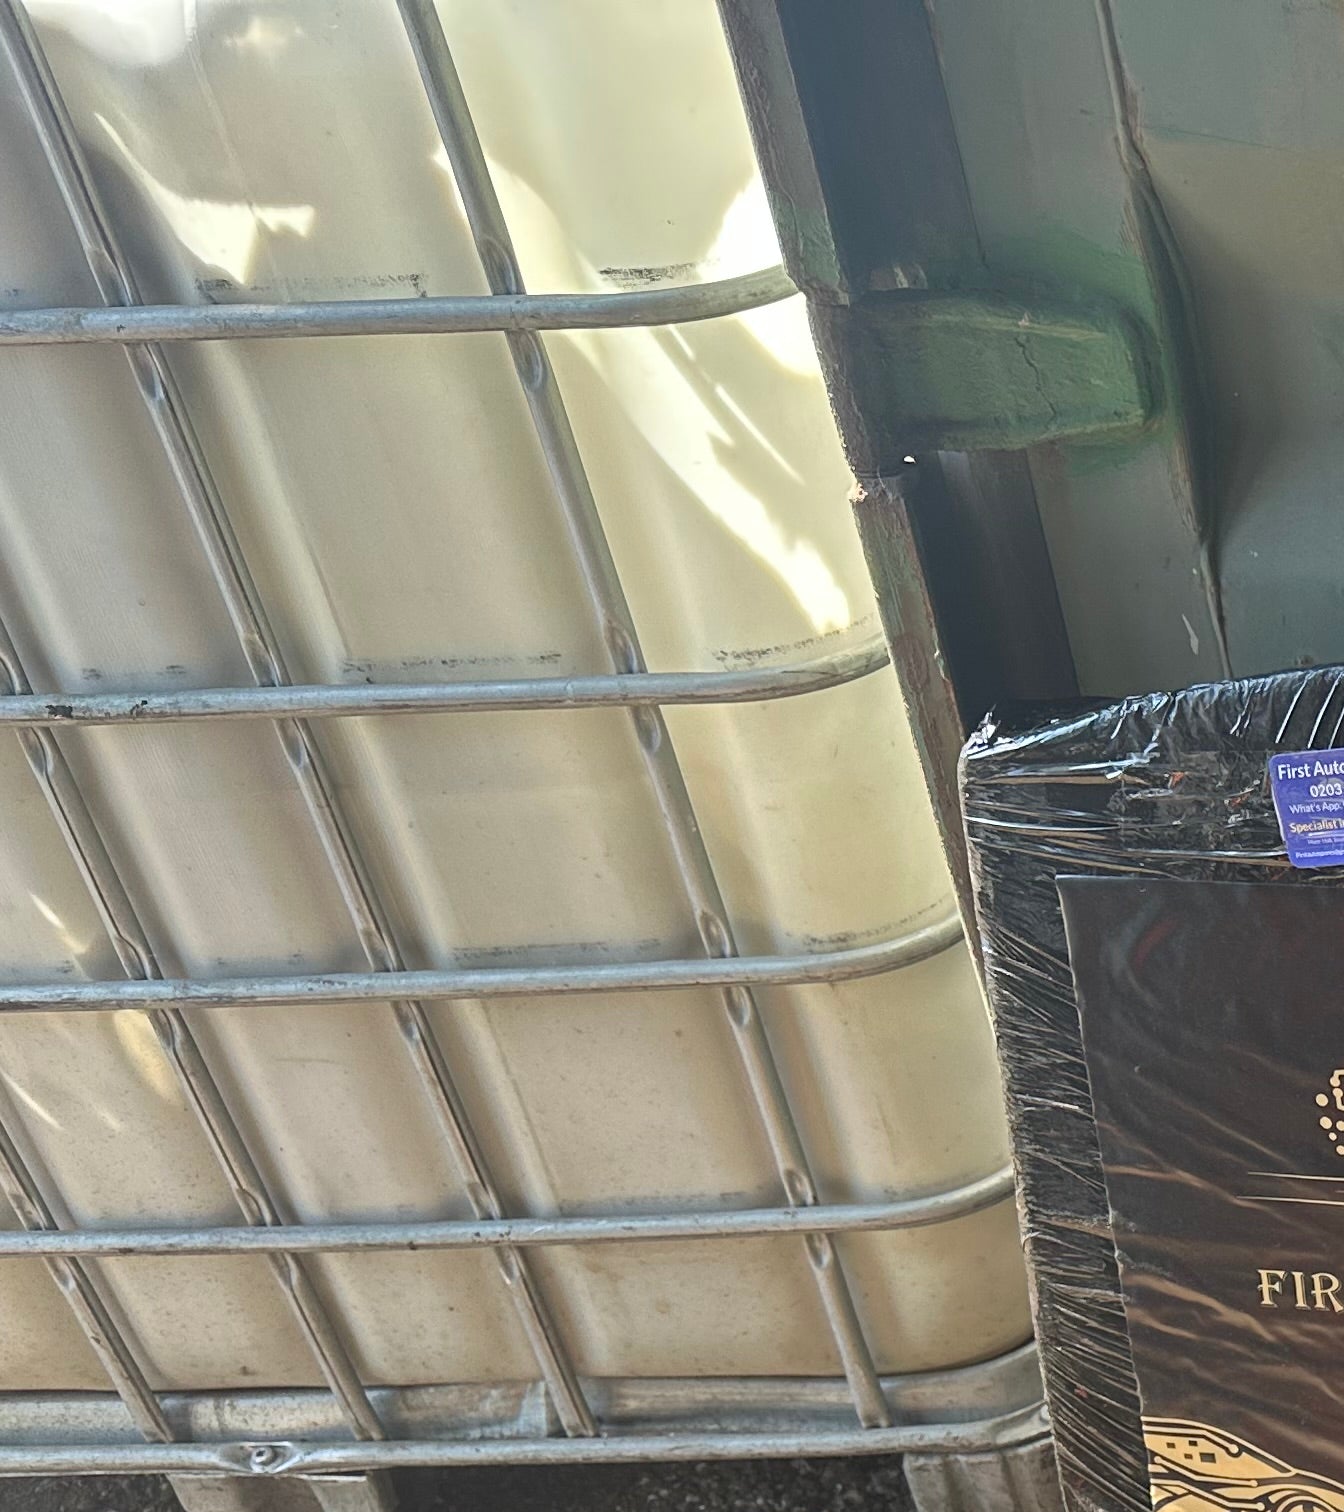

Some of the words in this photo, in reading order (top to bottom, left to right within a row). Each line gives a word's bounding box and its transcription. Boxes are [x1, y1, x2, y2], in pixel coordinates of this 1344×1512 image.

[1277, 763, 1311, 781] First
[1309, 785, 1342, 798] 0203
[1289, 820, 1338, 834] Specialist
